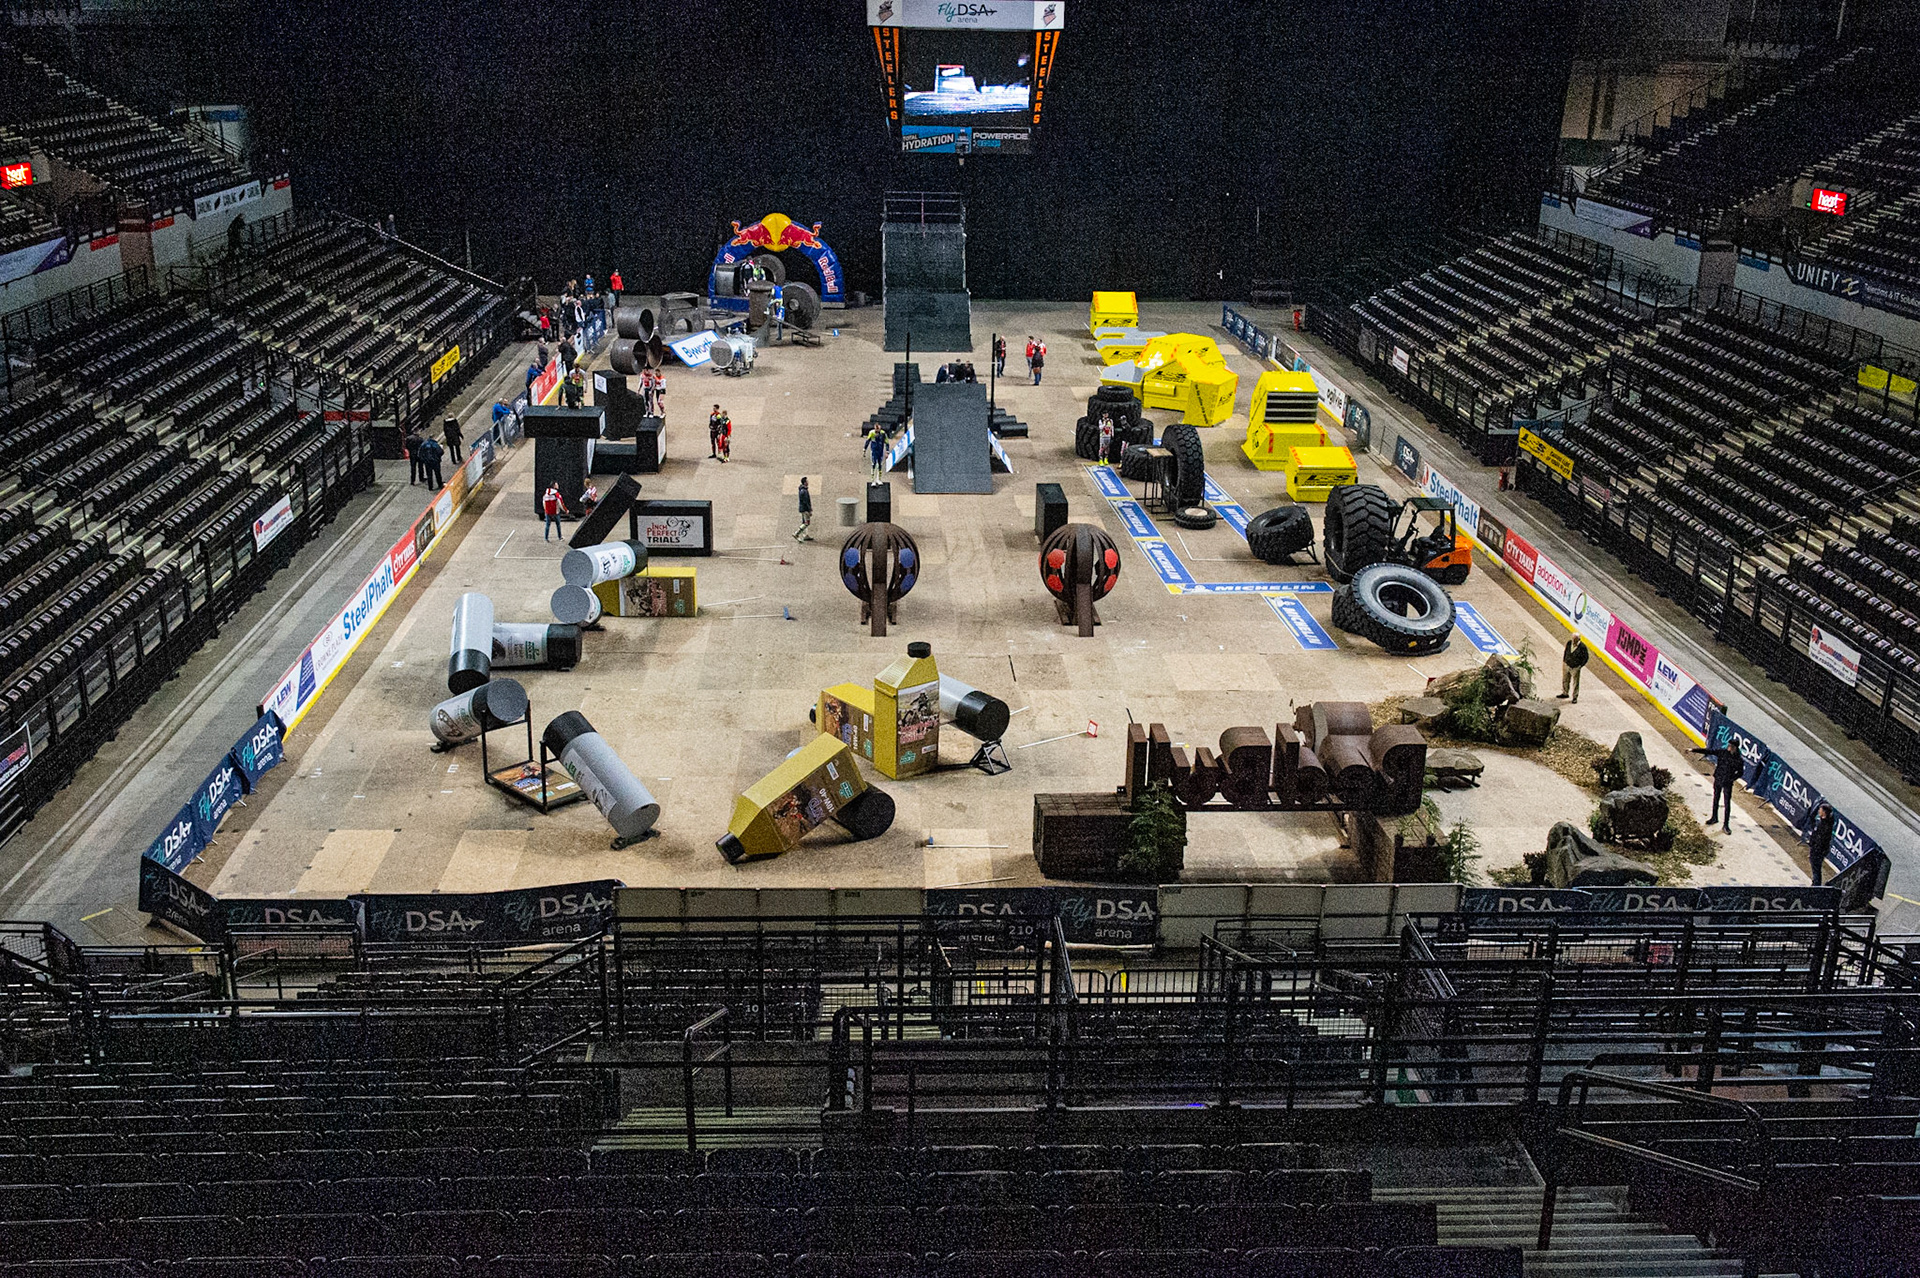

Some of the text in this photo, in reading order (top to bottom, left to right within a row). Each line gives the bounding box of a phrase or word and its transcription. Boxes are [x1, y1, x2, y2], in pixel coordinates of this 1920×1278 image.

[882, 28, 898, 120] STEELERS
[1033, 31, 1051, 124] STEELERS
[902, 133, 954, 150] HYDRATION
[903, 134, 918, 142] TOTAL
[973, 132, 1029, 140] POWERADE
[1798, 263, 1839, 290] UNIFY
[1097, 470, 1121, 495] MICHELIN
[1430, 472, 1478, 529] SteelPhalt
[652, 522, 668, 530] INCH
[1121, 507, 1149, 534] MICHELIN
[646, 527, 678, 536] PERFECT
[1152, 549, 1183, 580] MICHELIN
[1216, 584, 1316, 592] MICHELIN
[1537, 565, 1564, 595] adoption
[343, 565, 393, 640] SteelPhalt
[1280, 604, 1323, 645] MICHELIN
[1616, 626, 1641, 661] JUMP
[1658, 660, 1678, 683] LEW
[277, 681, 292, 706] LEW
[257, 751, 273, 771] arena
[214, 799, 227, 819] arena
[819, 787, 835, 813] 10W-40
[1779, 796, 1796, 816] arena
[1830, 845, 1849, 867] arena
[540, 892, 599, 918] DSA
[1096, 899, 1154, 920] DSA
[1624, 894, 1679, 912] DSA
[406, 911, 466, 931] DSA
[542, 921, 581, 936] arena
[1008, 926, 1034, 935] 210
[1443, 923, 1467, 932] 211
[1095, 927, 1132, 938] arena
